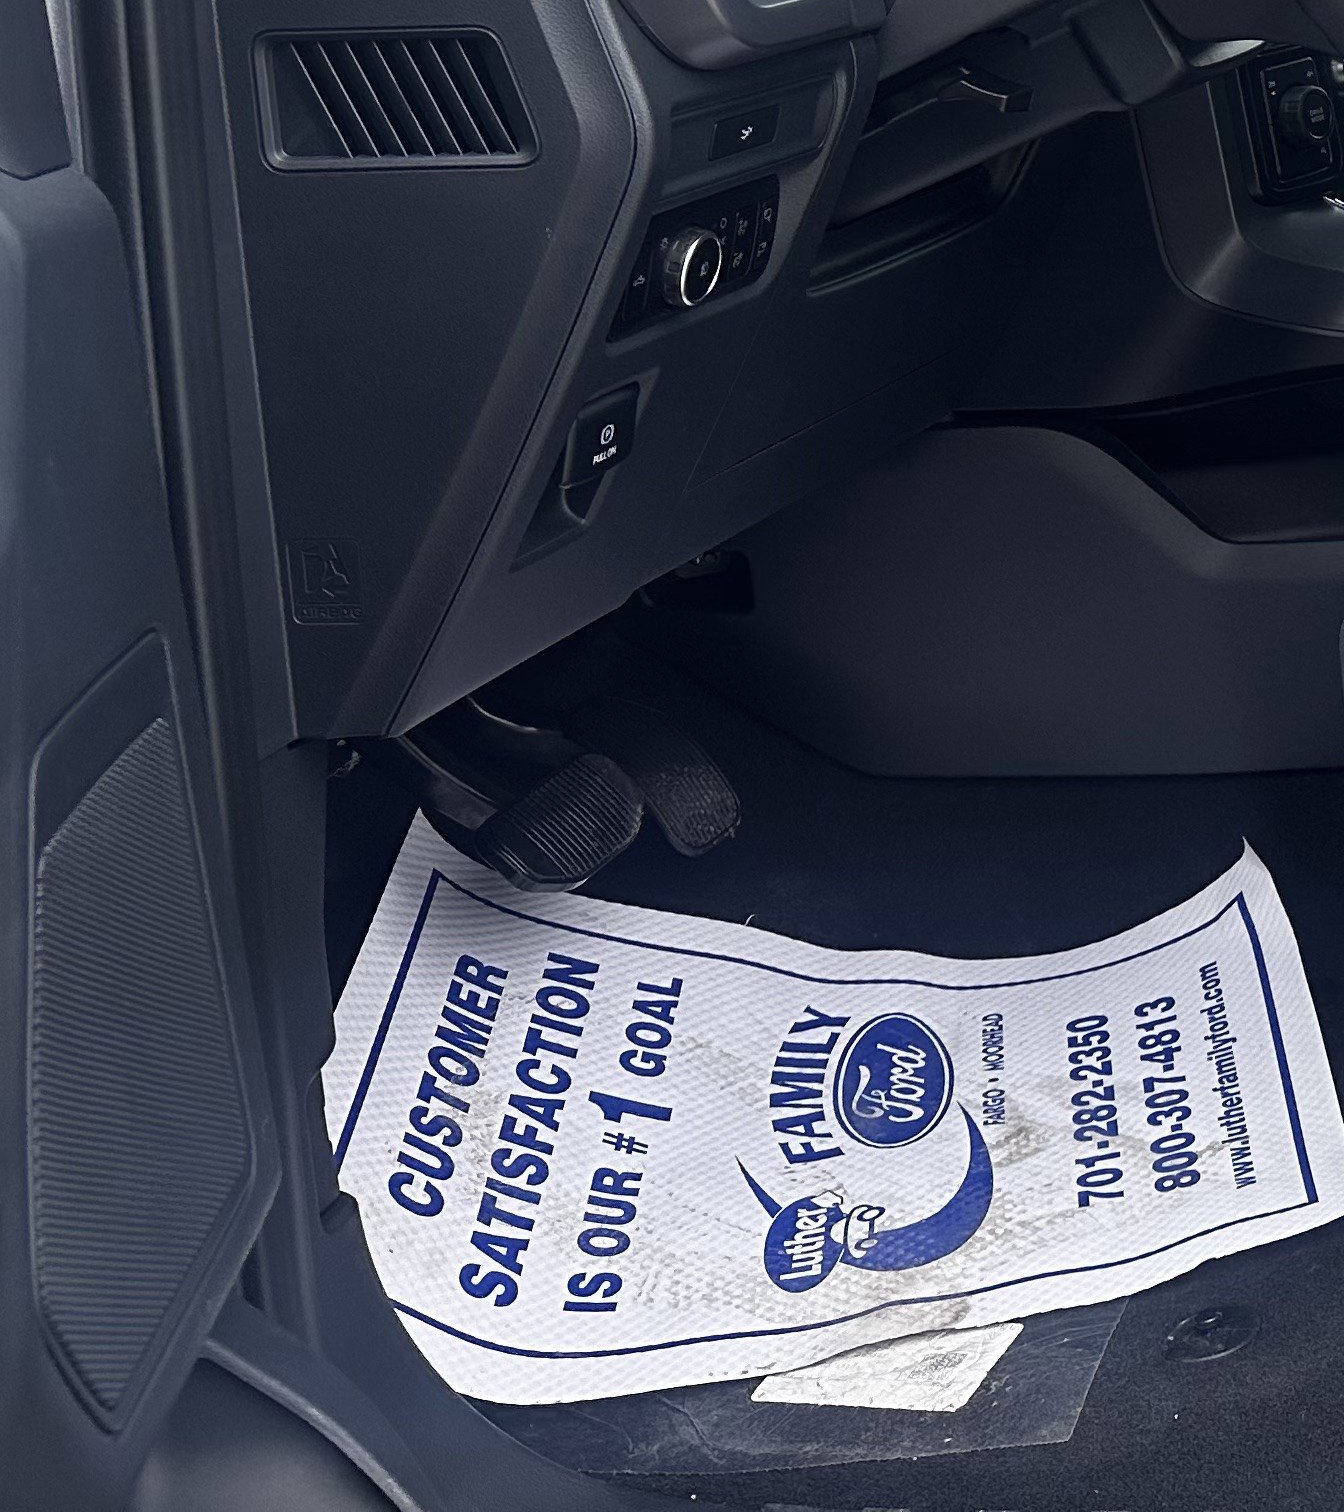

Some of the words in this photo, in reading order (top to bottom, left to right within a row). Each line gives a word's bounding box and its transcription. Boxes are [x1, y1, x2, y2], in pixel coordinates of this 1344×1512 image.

[593, 451, 607, 466] PULL
[607, 445, 617, 458] ON
[619, 977, 683, 1077] GOAL
[981, 1012, 1005, 1072] MOORHEAD
[388, 954, 509, 1217] CUSTOMER
[769, 1004, 851, 1165] FAMILY
[852, 1043, 927, 1123] Ford
[982, 1088, 1006, 1126] FARGO
[1066, 1014, 1125, 1208] 701-282-2350
[1133, 996, 1202, 1193] 800-307-4813
[1198, 960, 1257, 1190] www.lutherfamilyford.com
[458, 952, 600, 1307] SATISFACTION
[577, 1167, 643, 1257] OUR
[780, 1207, 828, 1281] Luther
[562, 1272, 623, 1313] IS
